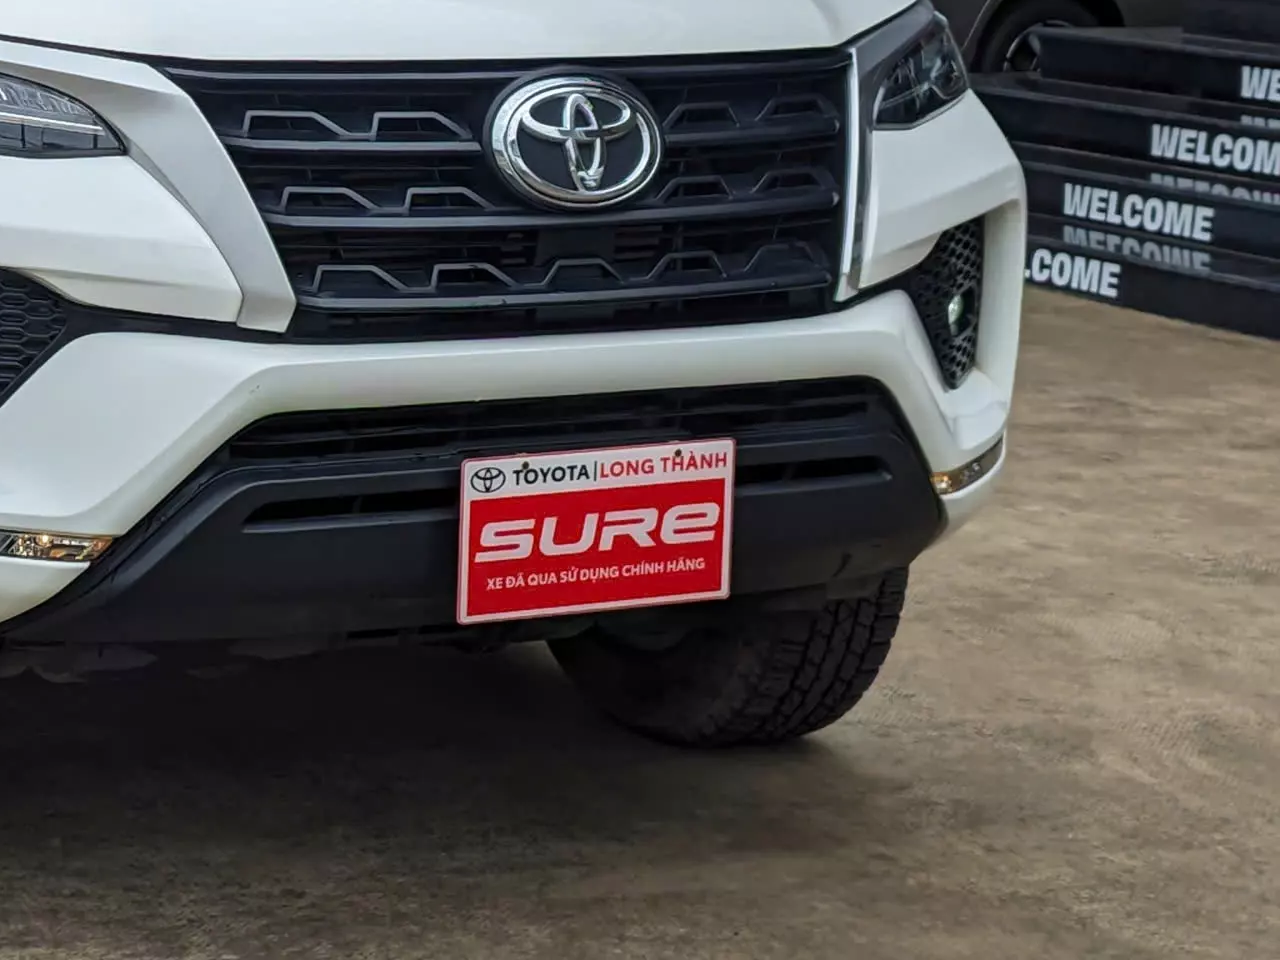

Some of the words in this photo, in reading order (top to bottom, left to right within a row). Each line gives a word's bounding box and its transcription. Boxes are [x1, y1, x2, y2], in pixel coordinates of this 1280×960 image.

[1063, 182, 1216, 242] WELCOME
[1025, 248, 1121, 298] COME
[513, 464, 590, 486] TOYOTA
[599, 459, 655, 479] LONG
[661, 450, 727, 473] THÀNH
[486, 577, 503, 590] XE
[505, 573, 526, 588] ĐÃ
[527, 571, 558, 586] QUA
[579, 566, 620, 585] DỤNG
[621, 561, 665, 577] CHÍNH
[666, 555, 706, 572] HÃNG
